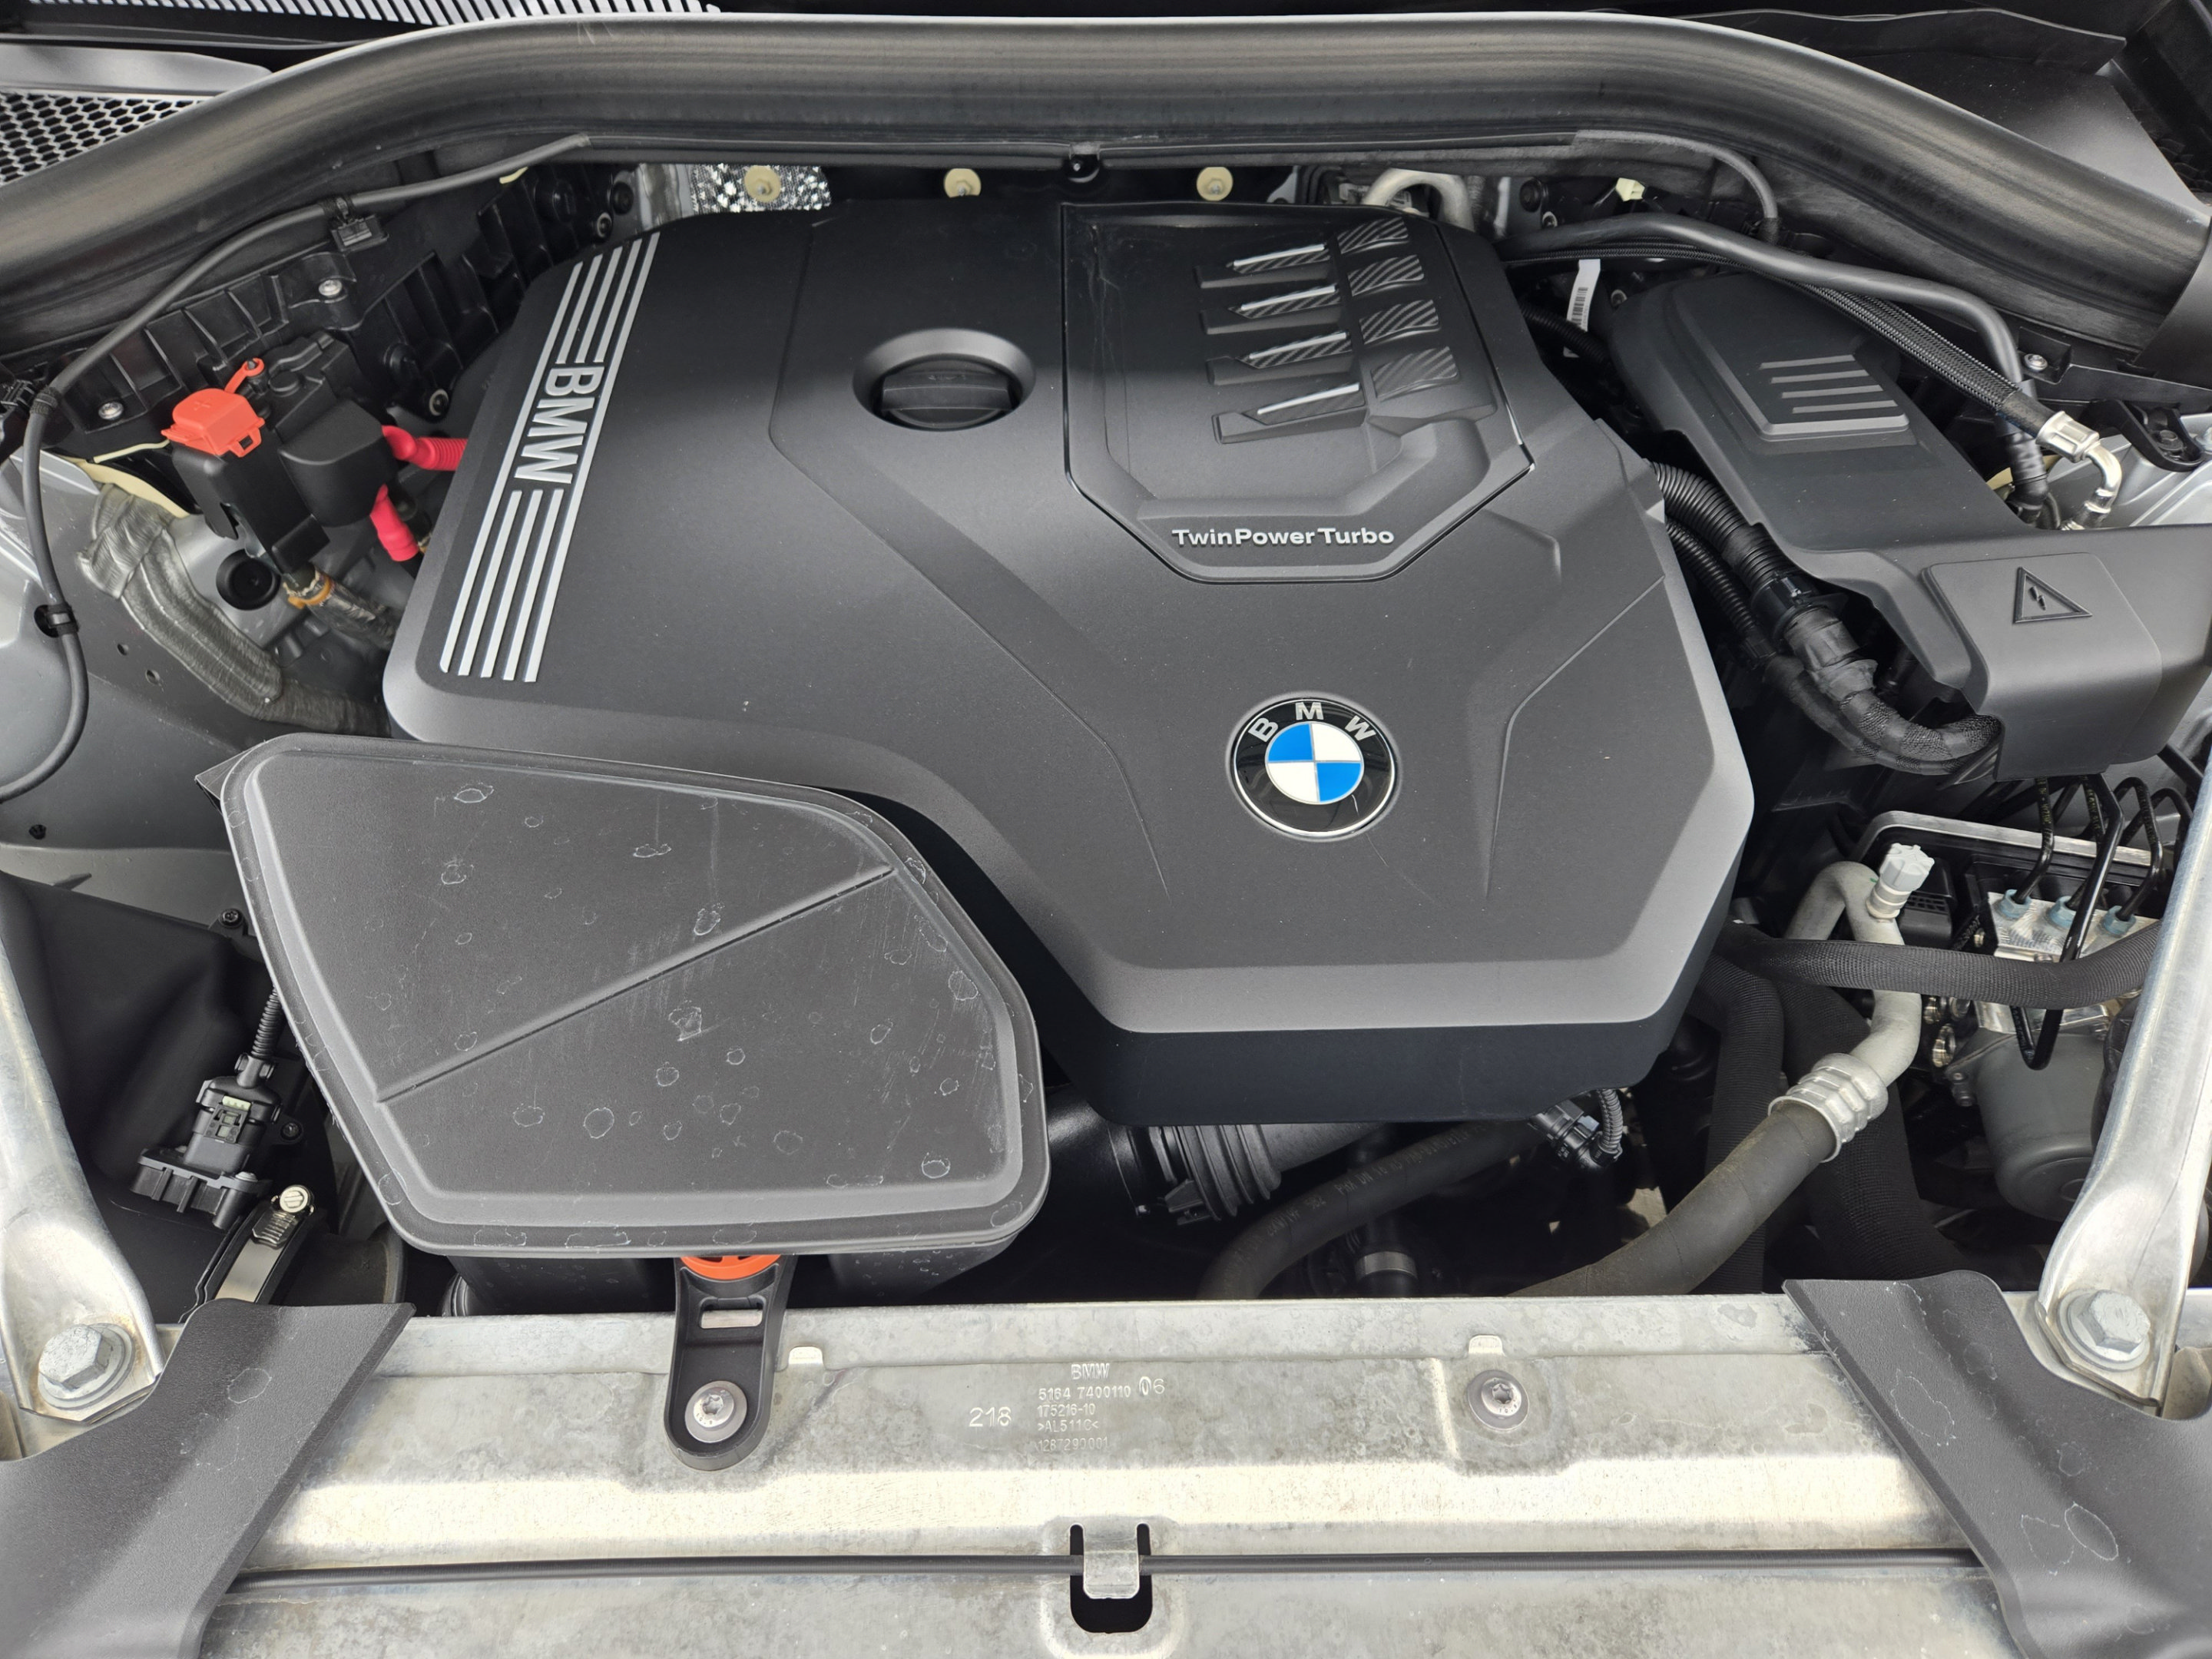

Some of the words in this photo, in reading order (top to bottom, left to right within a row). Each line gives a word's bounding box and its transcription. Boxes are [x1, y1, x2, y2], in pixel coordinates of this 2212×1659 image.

[514, 366, 605, 485] BMW
[1247, 701, 1377, 743] BMW
[1071, 1363, 1110, 1380] BMW
[1038, 1386, 1071, 1401] 5164
[1077, 1385, 1131, 1399] 7400110
[1138, 1376, 1166, 1396] 06
[969, 1406, 1012, 1428] 218
[1037, 1403, 1096, 1418] 175216-10
